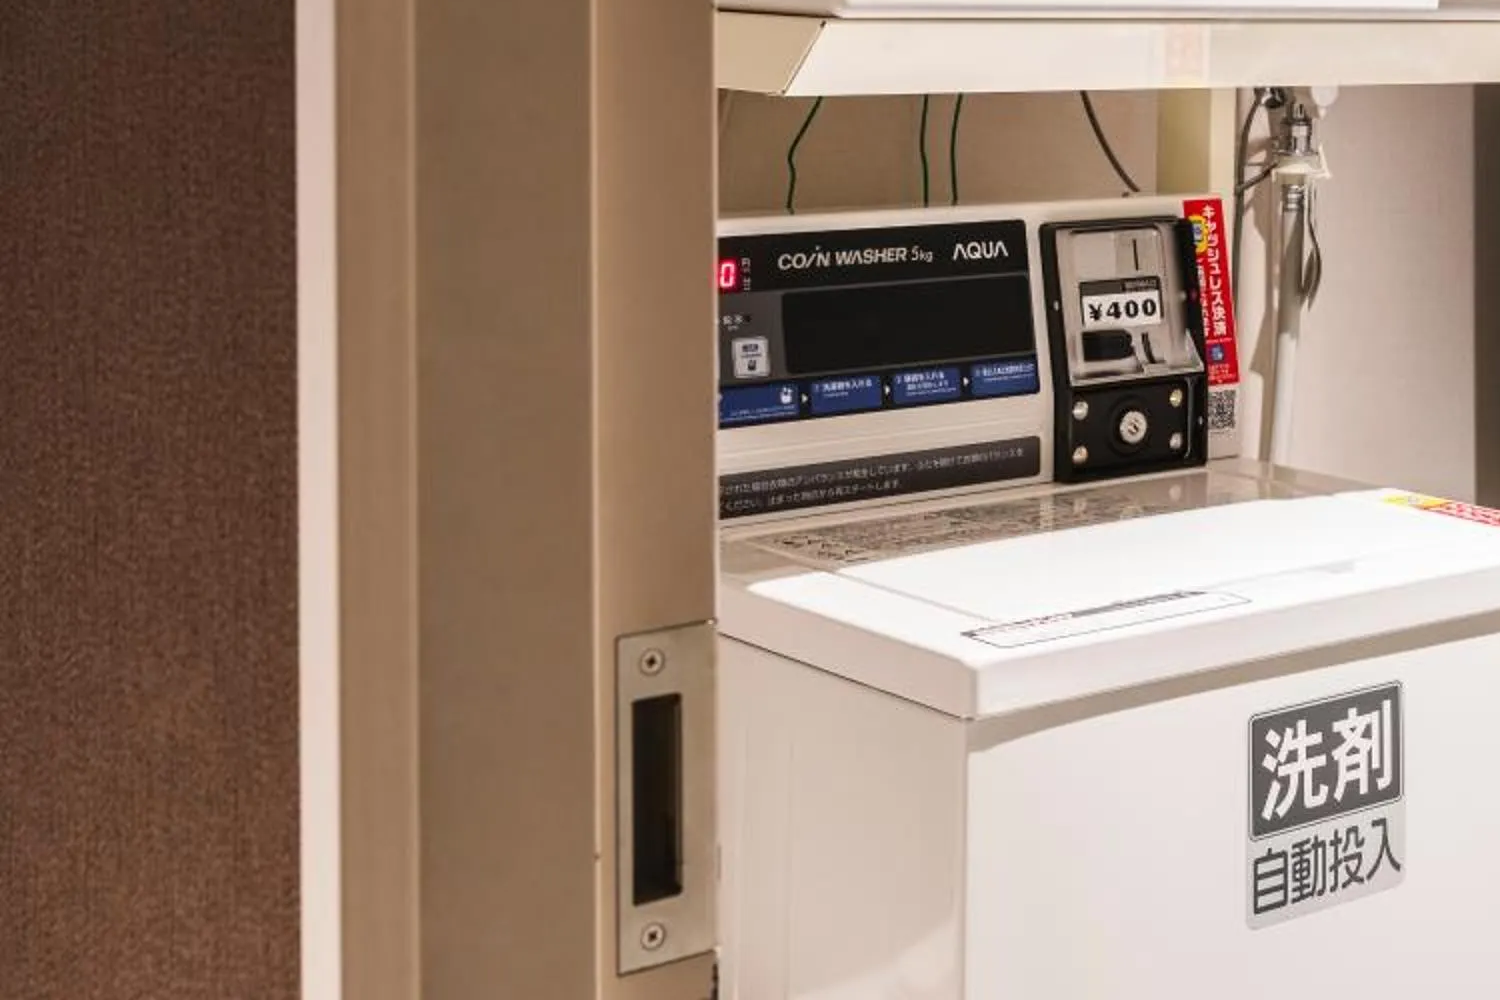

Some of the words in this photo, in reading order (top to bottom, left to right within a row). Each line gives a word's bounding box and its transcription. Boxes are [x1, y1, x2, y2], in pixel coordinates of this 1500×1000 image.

[777, 245, 830, 271] COIN
[835, 246, 907, 268] WASHER
[911, 245, 934, 263] 5kg
[953, 241, 1009, 261] AQUA
[1088, 299, 1157, 321] ¥400
[1261, 699, 1393, 821] 洗剤
[1253, 817, 1402, 916] 自動投入
